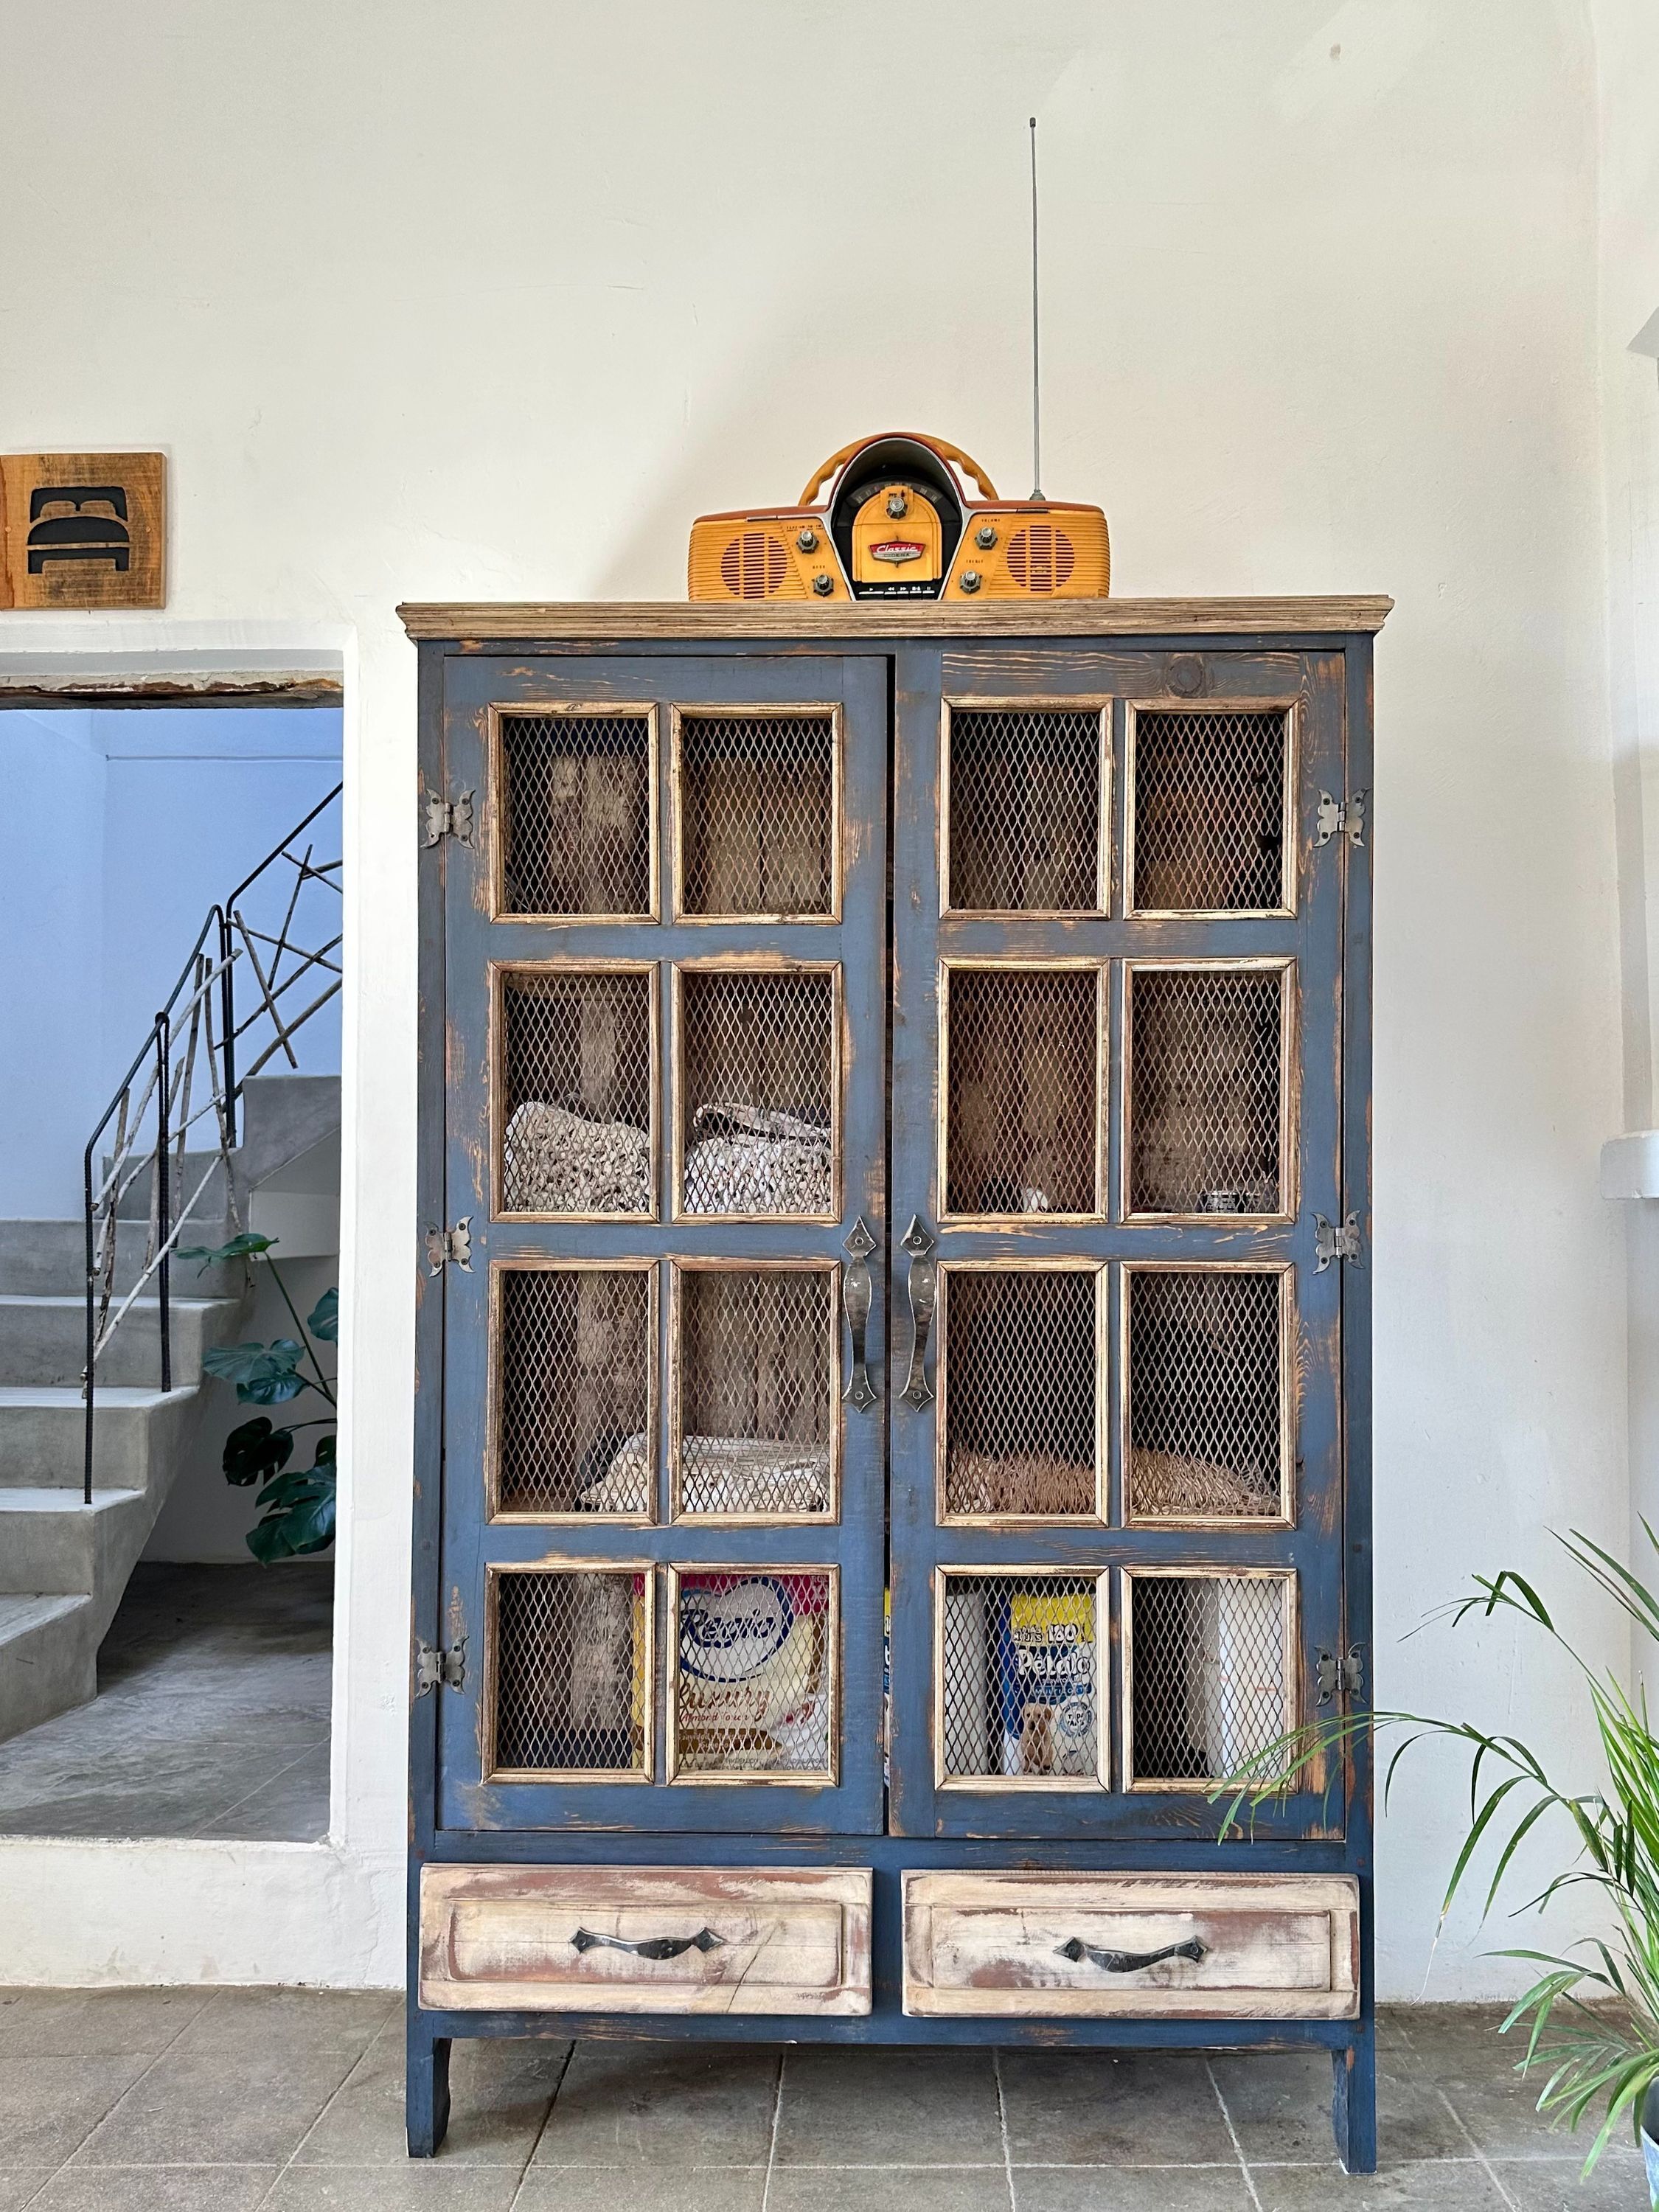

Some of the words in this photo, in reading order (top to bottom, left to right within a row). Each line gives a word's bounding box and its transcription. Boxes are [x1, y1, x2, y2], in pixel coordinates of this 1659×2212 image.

[876, 544, 918, 553] Classic
[1046, 1623, 1078, 1644] 180
[679, 1682, 770, 1722] Luxury
